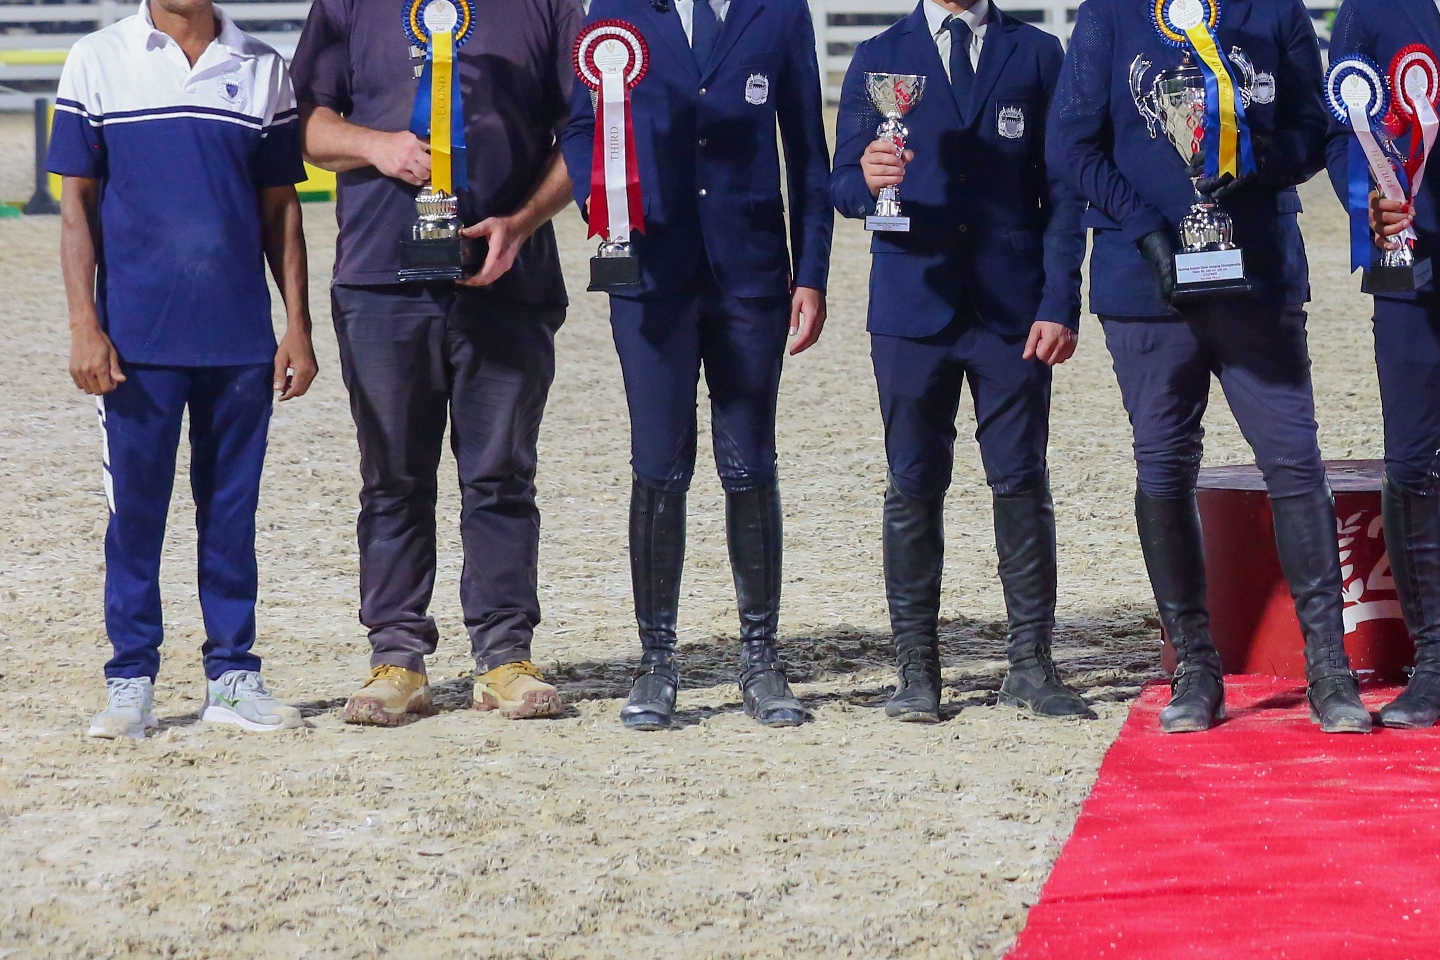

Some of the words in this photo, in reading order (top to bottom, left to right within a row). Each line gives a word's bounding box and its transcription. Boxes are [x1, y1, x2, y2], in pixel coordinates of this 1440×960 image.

[436, 75, 447, 124] SECOND
[610, 125, 620, 162] THIRD
[1370, 149, 1396, 188] FOURTH
